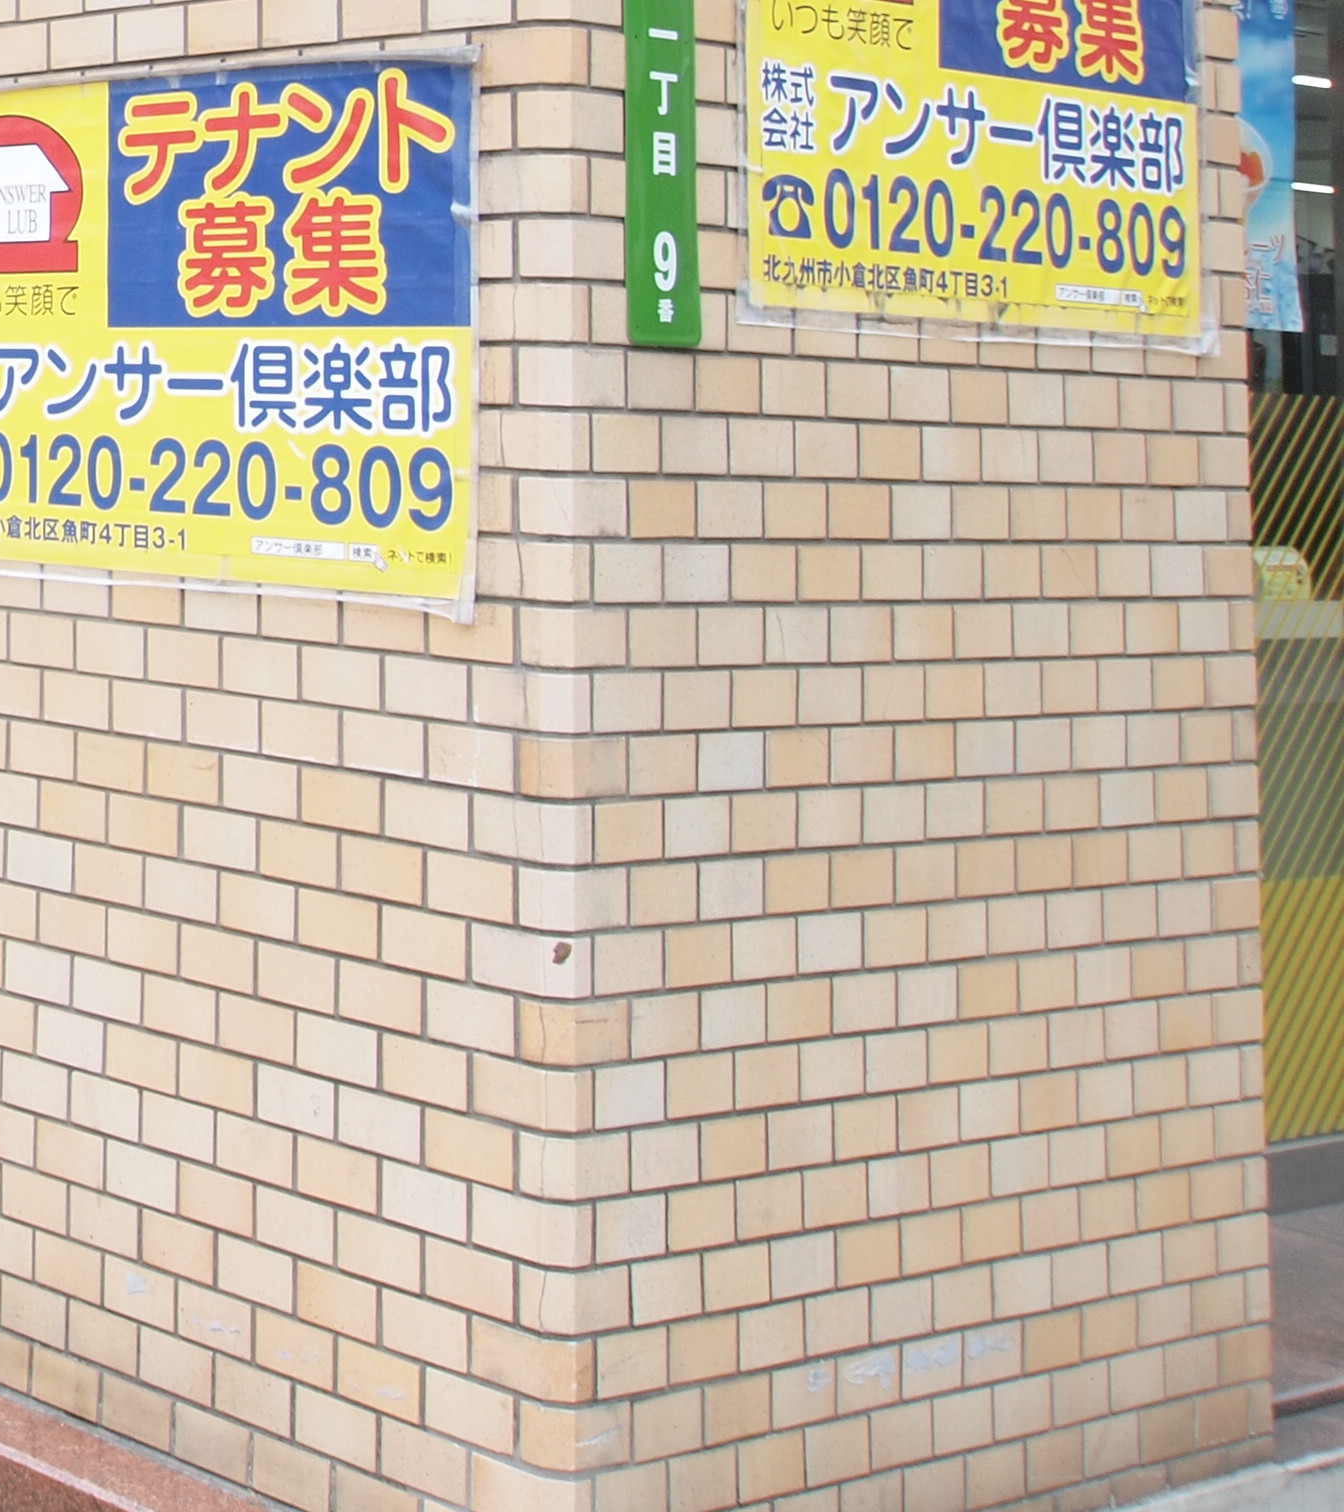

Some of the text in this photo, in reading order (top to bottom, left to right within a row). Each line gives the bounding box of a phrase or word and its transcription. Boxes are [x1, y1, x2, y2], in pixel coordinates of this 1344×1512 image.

[771, 0, 913, 52] いつも笑顔で
[761, 61, 815, 106] 株式
[118, 66, 456, 205] テナント
[761, 108, 815, 152] 会社
[828, 72, 1184, 195] アンサー倶楽部
[823, 168, 1186, 280] 0120-220-809
[177, 188, 386, 318] 募集
[762, 253, 1008, 299] 北九州市小倉北区魚町4丁目3-1
[254, 539, 324, 557] アンサー倶楽部
[352, 546, 373, 559] 検索
